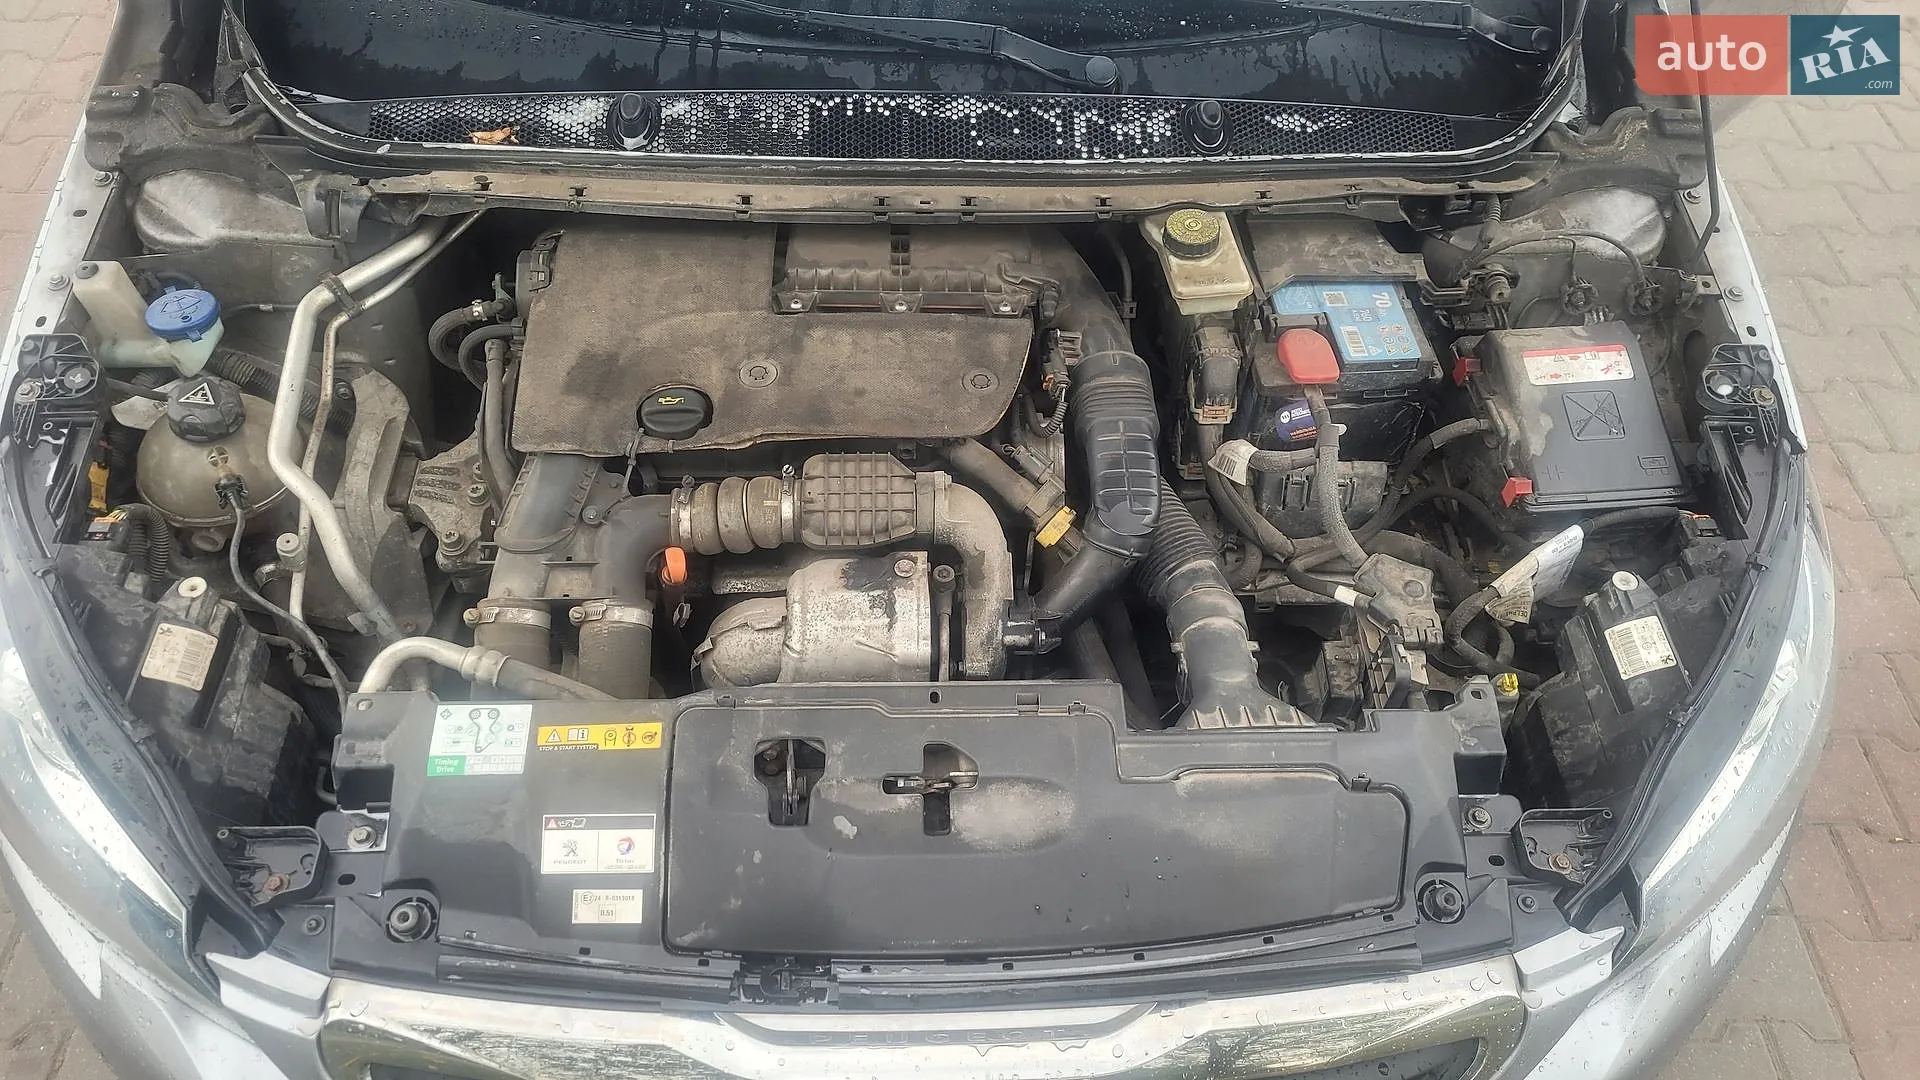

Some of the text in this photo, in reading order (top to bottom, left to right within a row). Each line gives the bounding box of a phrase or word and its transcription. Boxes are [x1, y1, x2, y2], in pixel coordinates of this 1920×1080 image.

[576, 743, 598, 751] SYSTEM
[434, 759, 459, 767] Timing
[436, 765, 456, 774] Drive
[810, 1028, 1065, 1045] PEUGEOT
